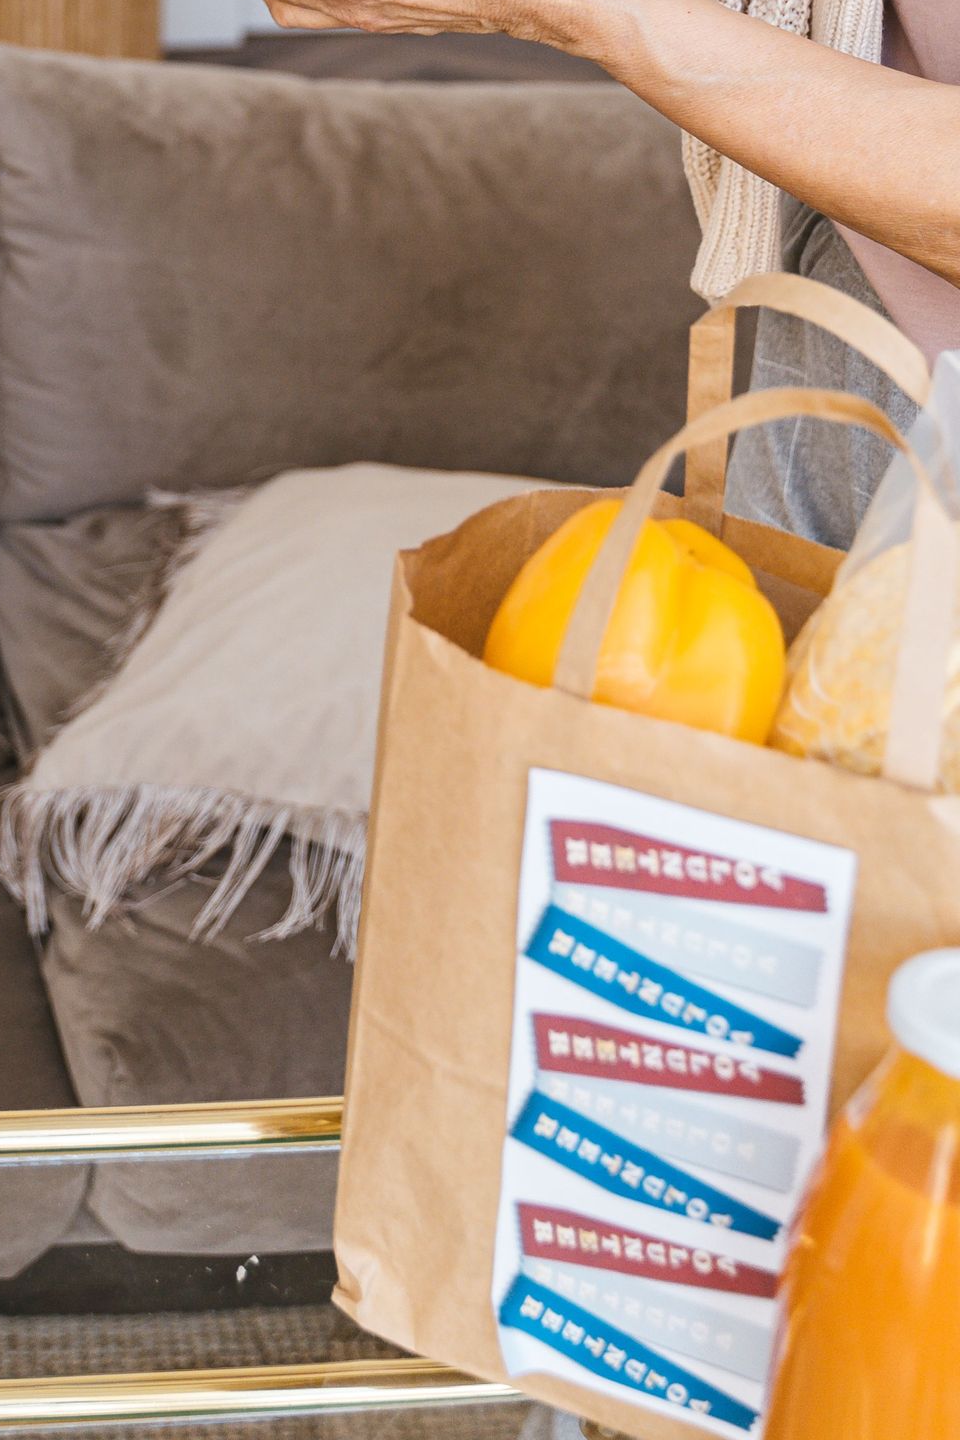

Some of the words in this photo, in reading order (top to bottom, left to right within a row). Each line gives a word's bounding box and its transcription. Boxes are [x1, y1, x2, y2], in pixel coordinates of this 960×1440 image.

[565, 837, 787, 893] VOLUNTEER
[549, 928, 755, 1047] VOLUNTEER
[549, 1029, 762, 1083] VOLUNTEER
[534, 1113, 734, 1230] VOLUNTEER
[532, 1218, 739, 1277] VOLUNTEER
[520, 1294, 713, 1416] VOLUNTEER
